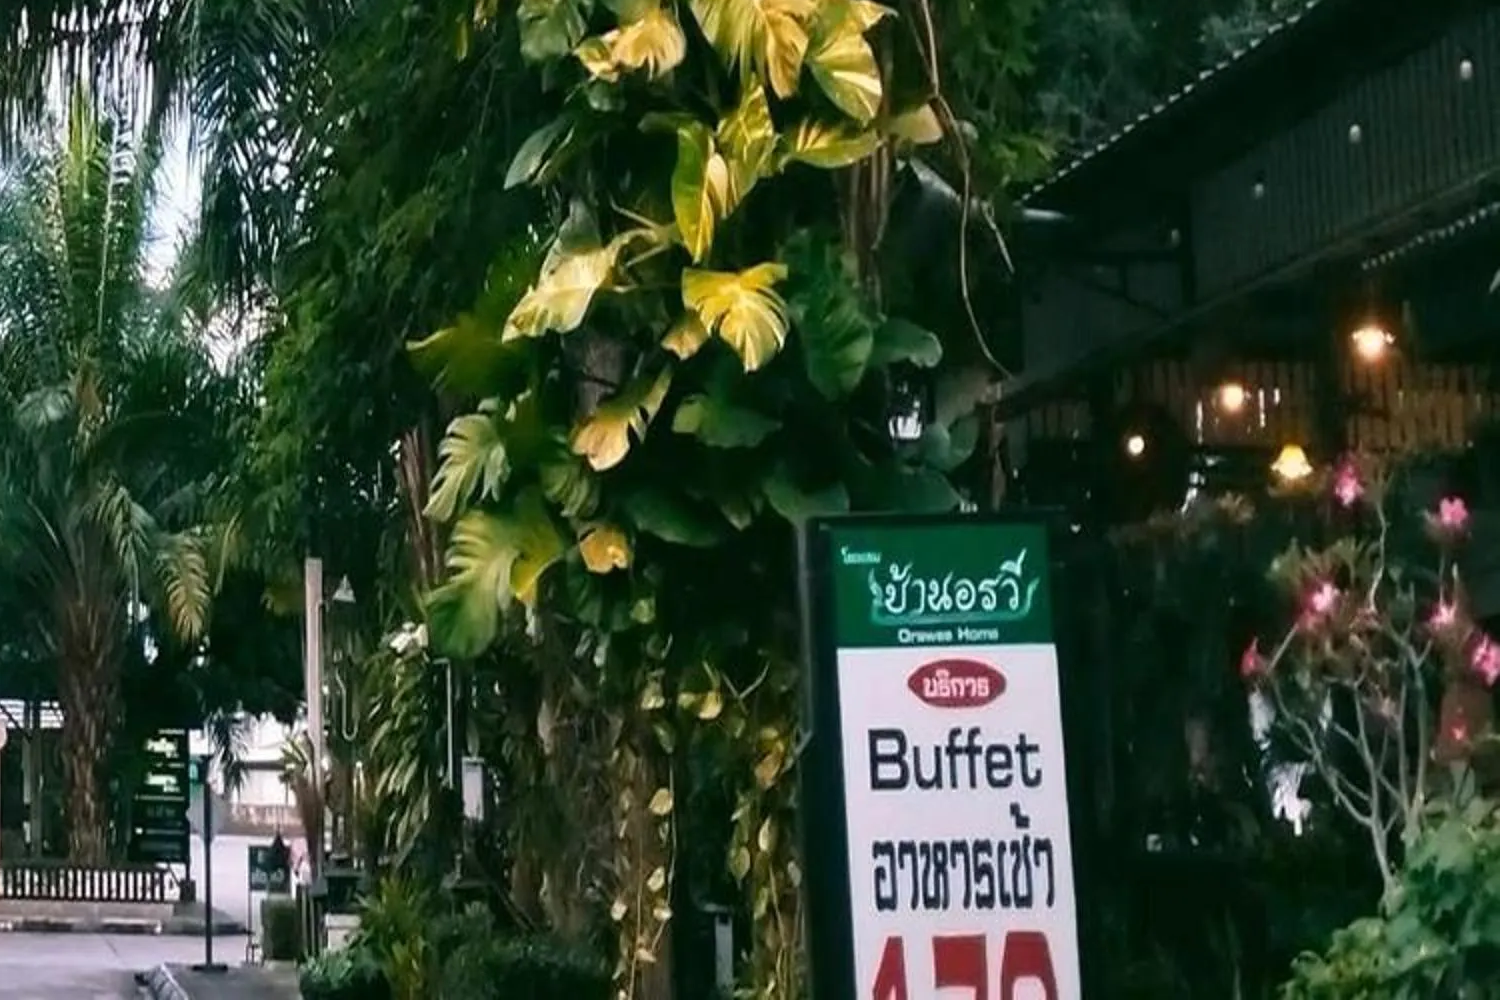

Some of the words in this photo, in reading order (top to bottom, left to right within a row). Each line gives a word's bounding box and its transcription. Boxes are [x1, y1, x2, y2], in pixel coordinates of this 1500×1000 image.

[884, 548, 1027, 614] บ้านอรวี
[957, 625, 999, 641] Home
[922, 668, 990, 698] บริการ
[867, 727, 1043, 791] Buffet
[871, 802, 1055, 912] อาหารเช้า
